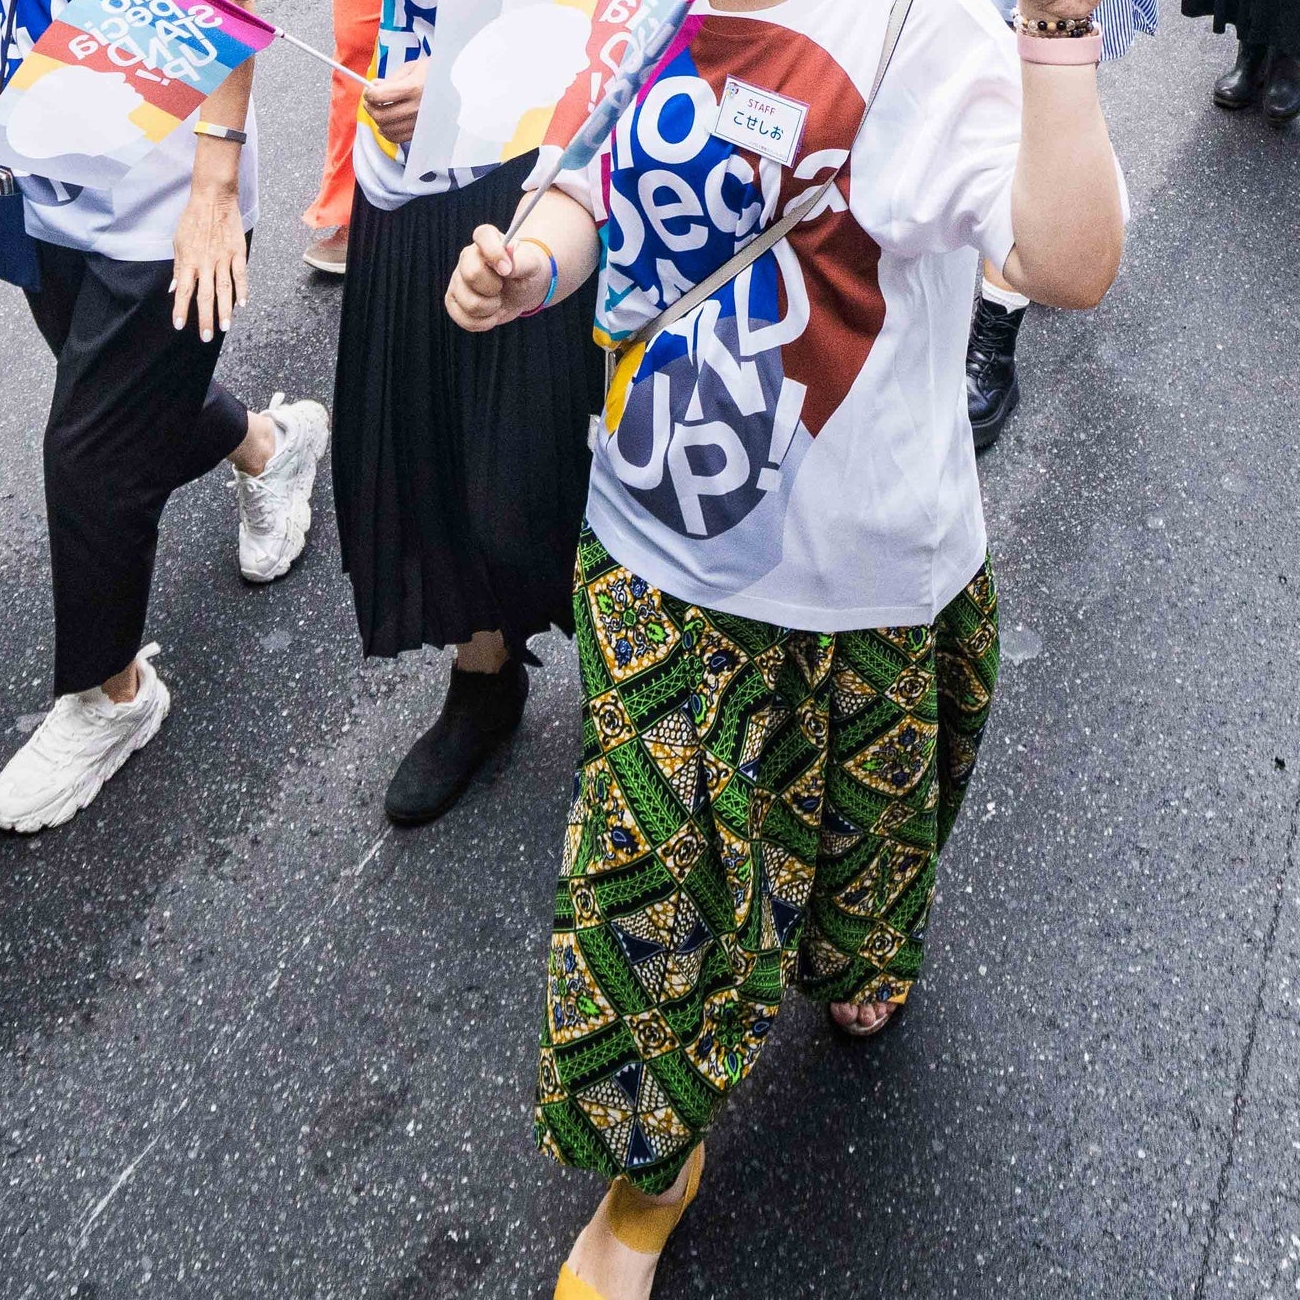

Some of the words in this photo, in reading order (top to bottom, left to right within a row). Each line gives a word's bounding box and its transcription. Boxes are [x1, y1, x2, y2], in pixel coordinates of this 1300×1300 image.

[747, 98, 776, 116] STAFF
[733, 111, 784, 141] こせしお
[608, 374, 807, 538] UP!
